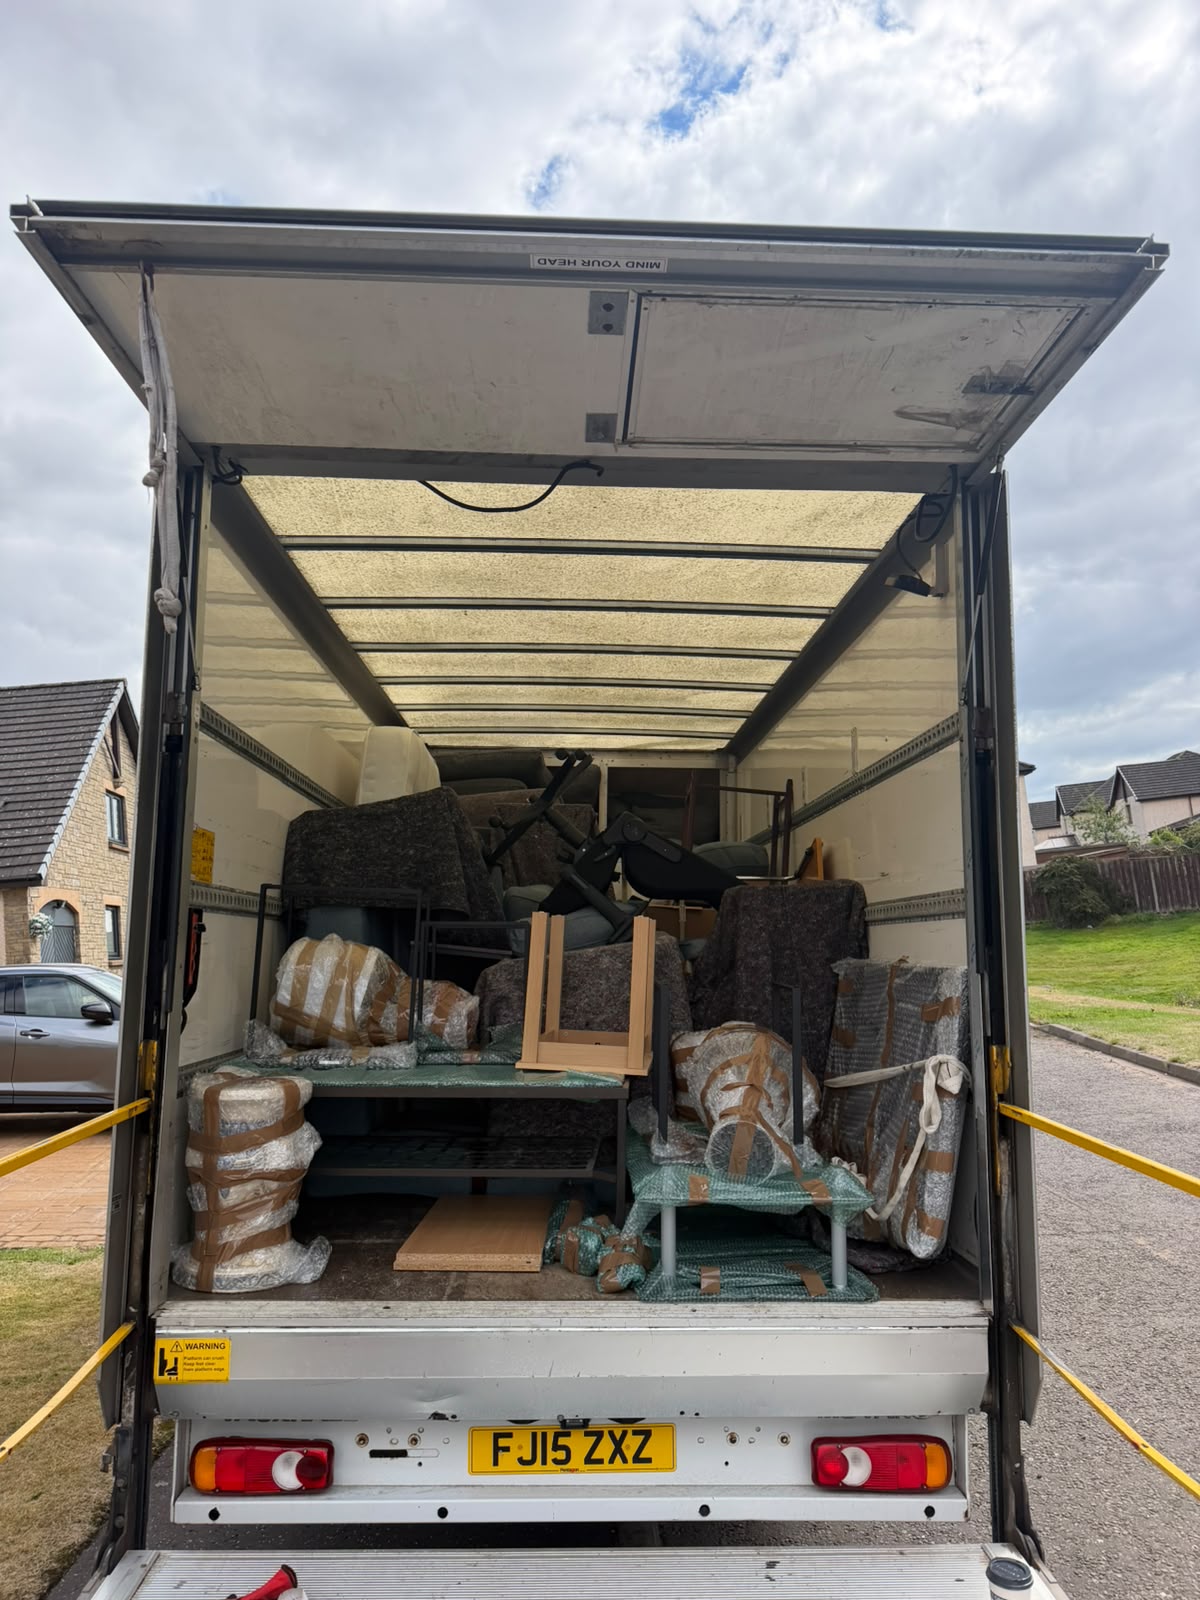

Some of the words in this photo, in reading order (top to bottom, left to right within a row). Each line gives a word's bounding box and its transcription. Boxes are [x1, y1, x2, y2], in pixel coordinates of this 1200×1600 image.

[537, 257, 577, 266] HEAD
[581, 259, 621, 268] YOUR
[625, 260, 661, 269] MIND
[185, 1342, 226, 1350] WARNING
[492, 1431, 572, 1467] FJ15
[583, 1429, 653, 1465] ZXZ
